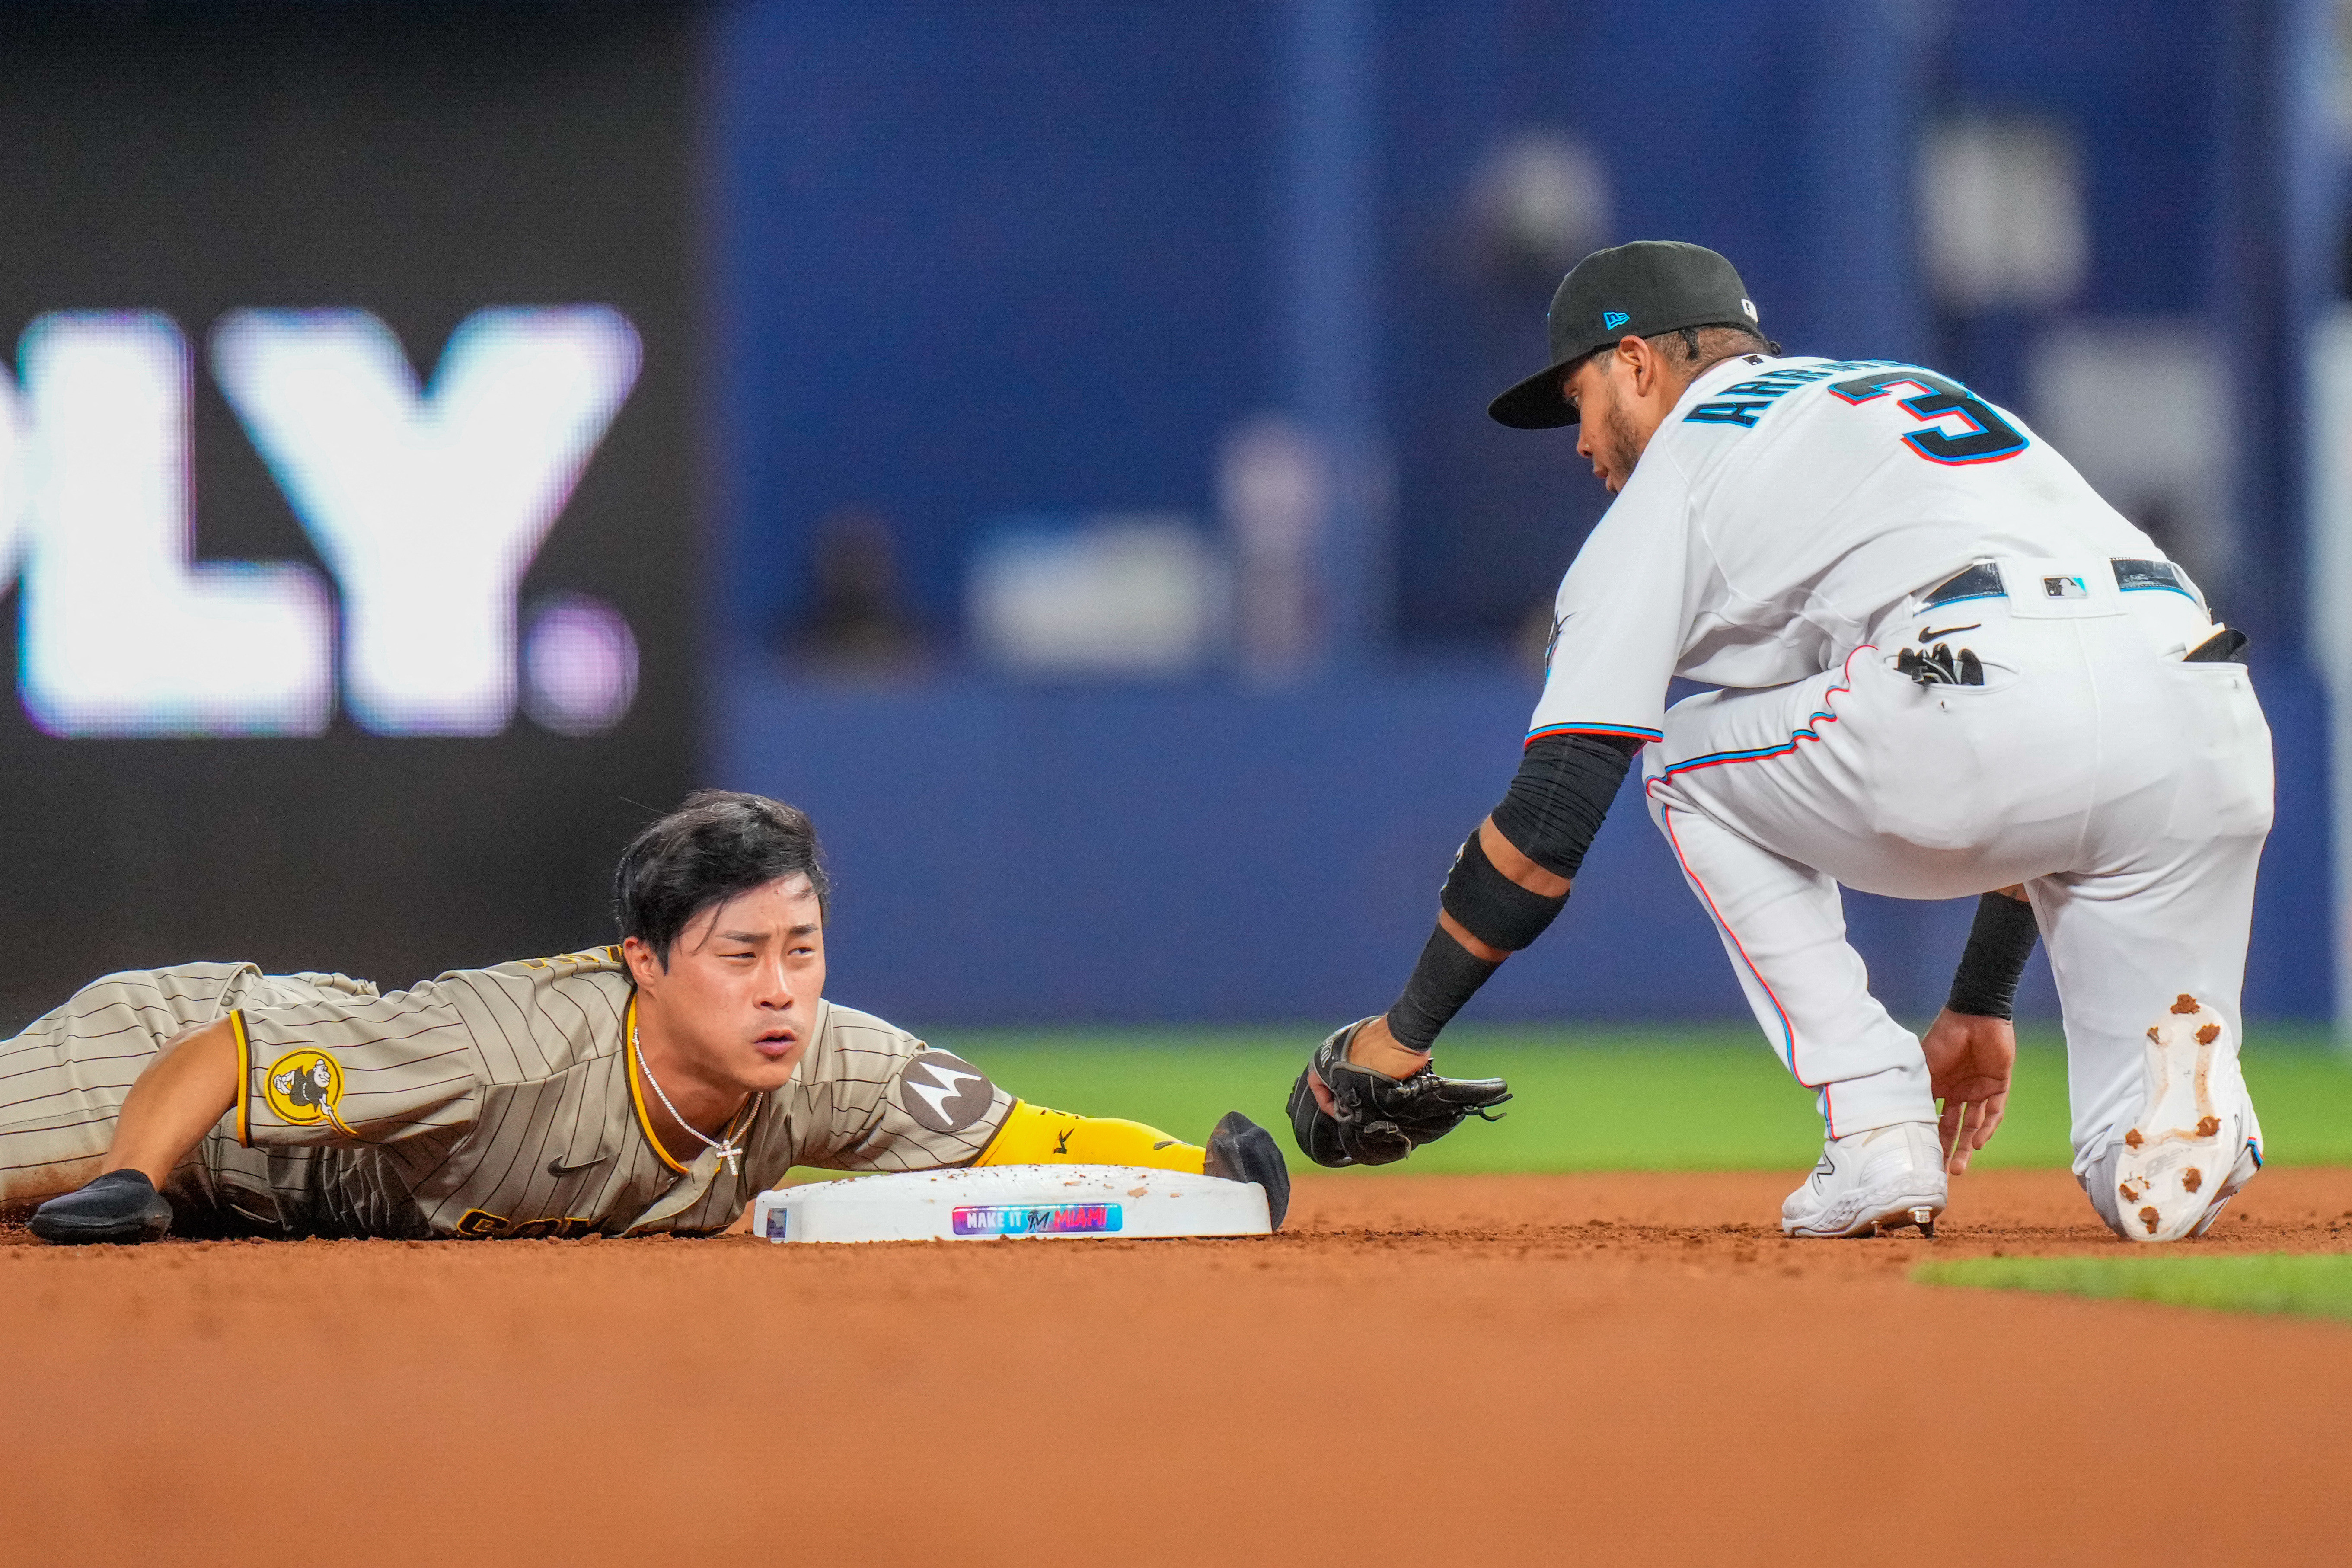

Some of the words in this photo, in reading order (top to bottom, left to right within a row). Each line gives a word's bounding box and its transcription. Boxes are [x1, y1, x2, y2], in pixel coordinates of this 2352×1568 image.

[1828, 371, 2030, 466] 3
[0, 303, 643, 738] LY.
[967, 1212, 1005, 1228] MAKE
[1009, 1211, 1021, 1227] IT
[1055, 1207, 1106, 1228] MIAMI
